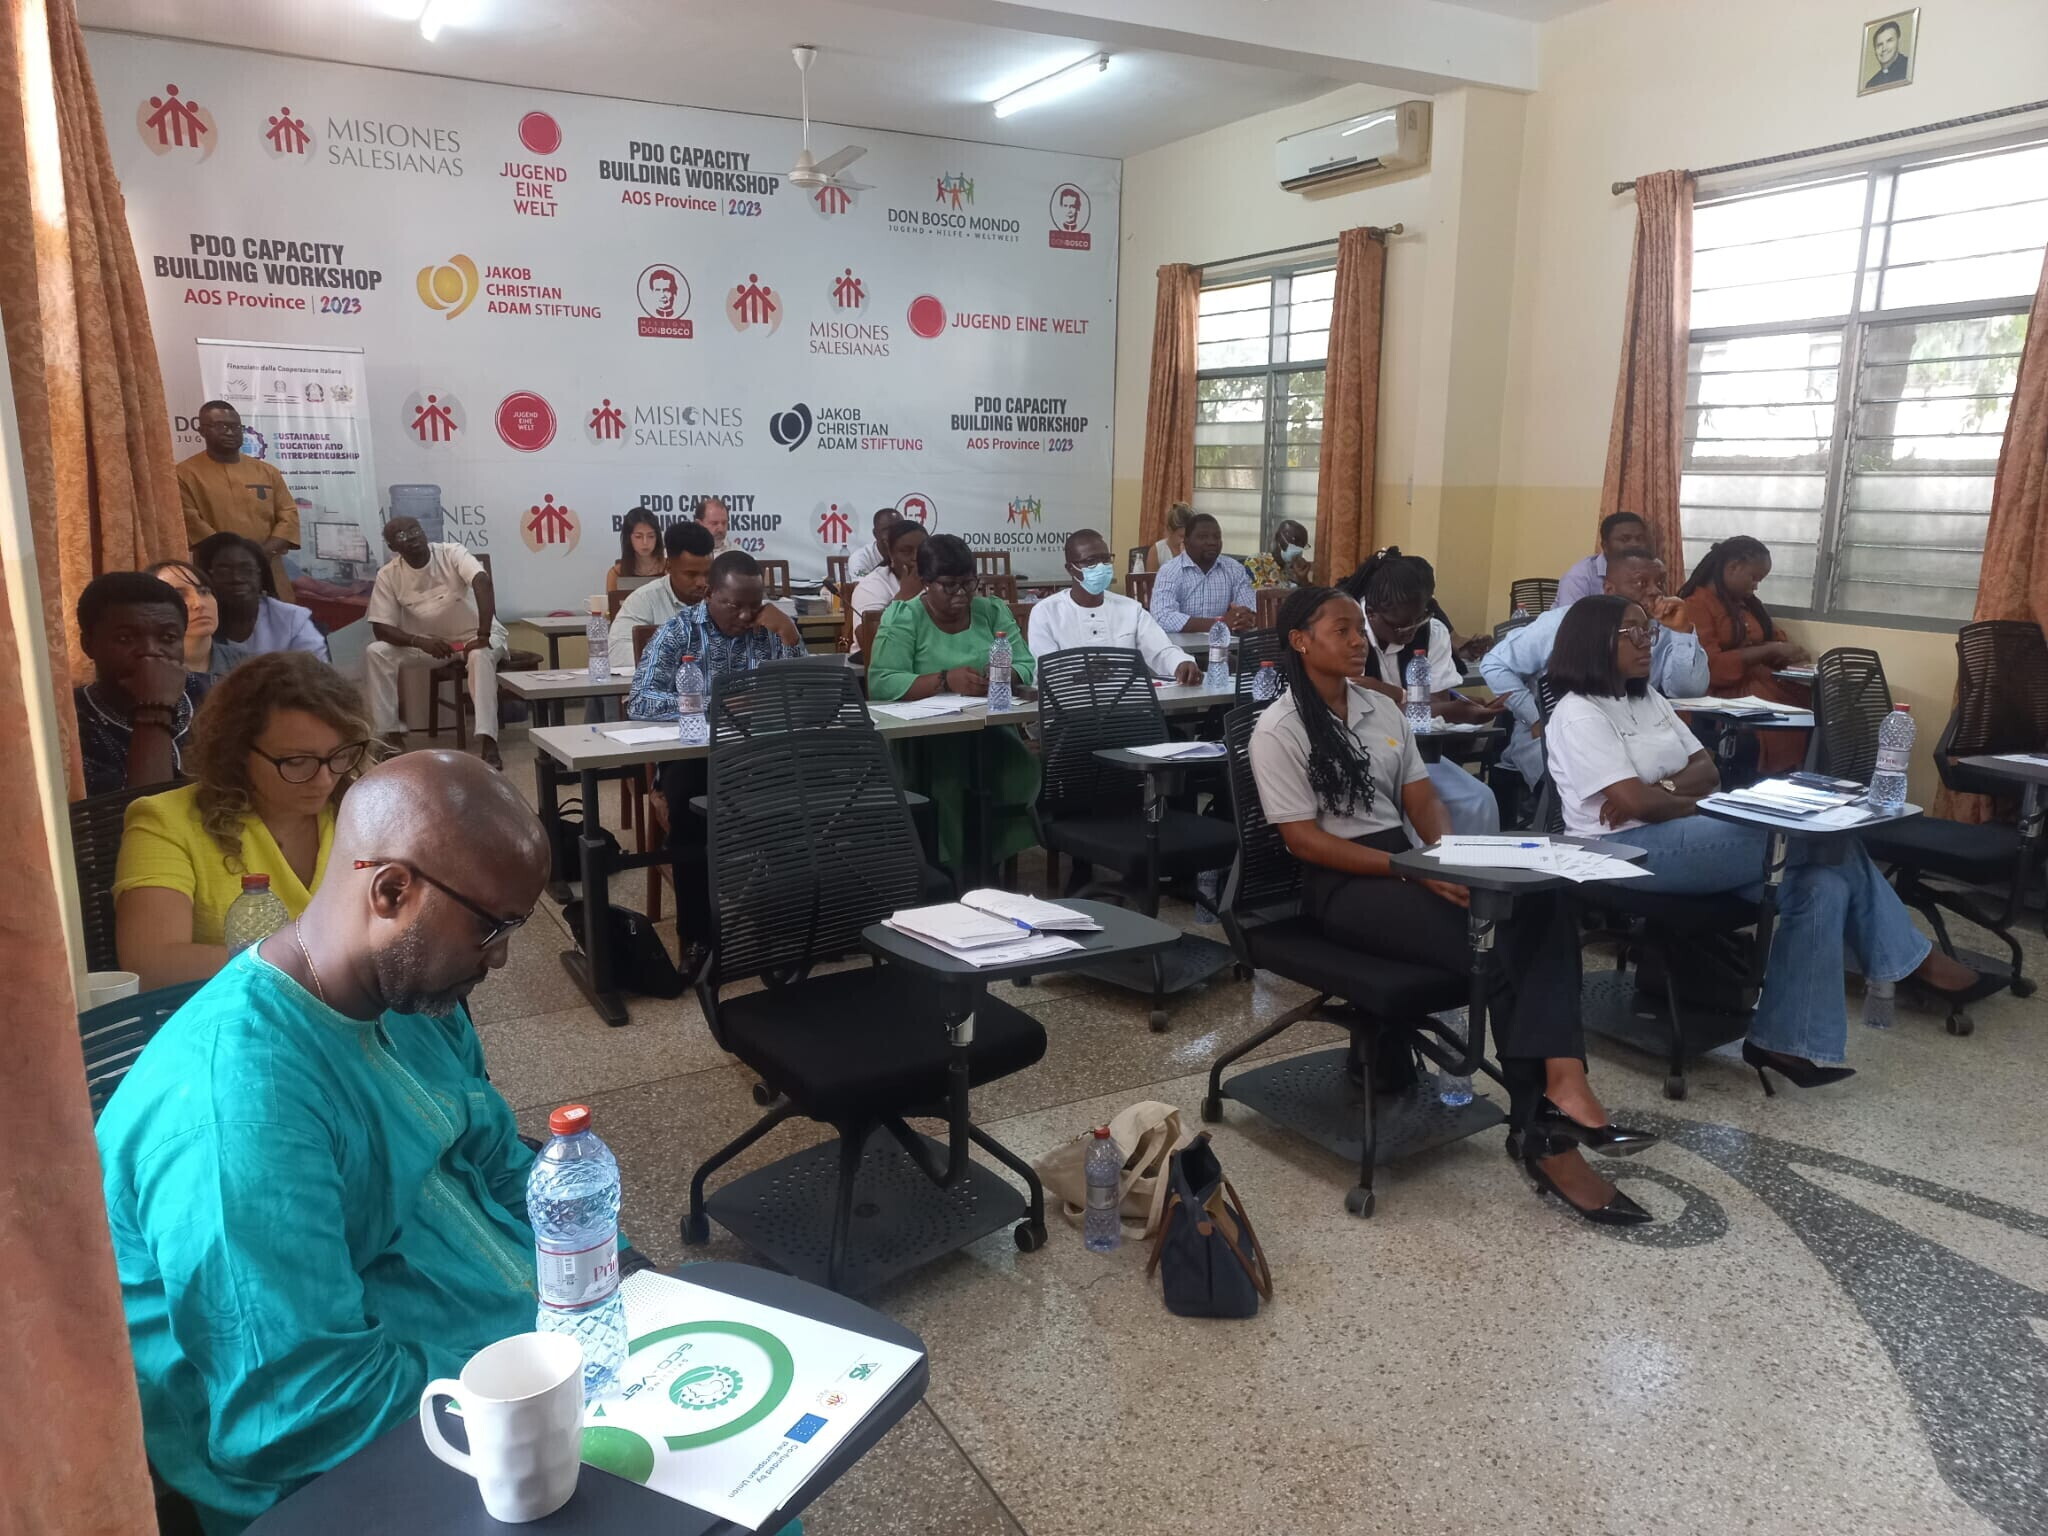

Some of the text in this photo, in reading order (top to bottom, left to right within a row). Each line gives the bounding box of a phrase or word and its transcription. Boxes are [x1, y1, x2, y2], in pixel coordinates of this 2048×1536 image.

[327, 117, 462, 154] MISIONES
[328, 144, 464, 178] SALESIANAS
[629, 140, 750, 172] PDO CAPACITY
[499, 162, 568, 183] JUGEND
[599, 159, 780, 196] BUILDING WORKSHOP
[516, 182, 554, 200] EINE
[513, 199, 558, 218] WELT
[621, 189, 762, 217] AOS Province 2023
[888, 208, 1020, 233] DON BOSCO MONDO
[888, 225, 1020, 243] JUGEND HILFE WELTWEIT
[190, 234, 345, 267] PDO CAPACITY
[153, 255, 382, 291] BUILDING WORKSHOP
[484, 265, 532, 281] JAKOB
[486, 283, 562, 300] CHRISTIAN
[184, 288, 362, 315] AOS Province 2023
[487, 300, 601, 320] ADAM STIFTUNG
[809, 321, 889, 341] MISIONES
[951, 313, 1089, 334] JUGEND EINE WELT
[809, 340, 890, 357] SALESIANAS
[816, 408, 861, 421] JAKOB
[974, 396, 1067, 415] PDO CAPACITY
[817, 422, 889, 436] CHRISTIAN
[951, 414, 1089, 433] BUILDING WORKSHOP
[635, 429, 744, 447] SALESIANAS
[817, 437, 923, 451] ADAM STIFTUNG
[966, 437, 1074, 452] AOS Province 2023
[640, 494, 674, 512] PDO
[963, 532, 991, 545] DON
[994, 532, 1034, 545] BOSCO
[728, 1480, 751, 1498] Union
